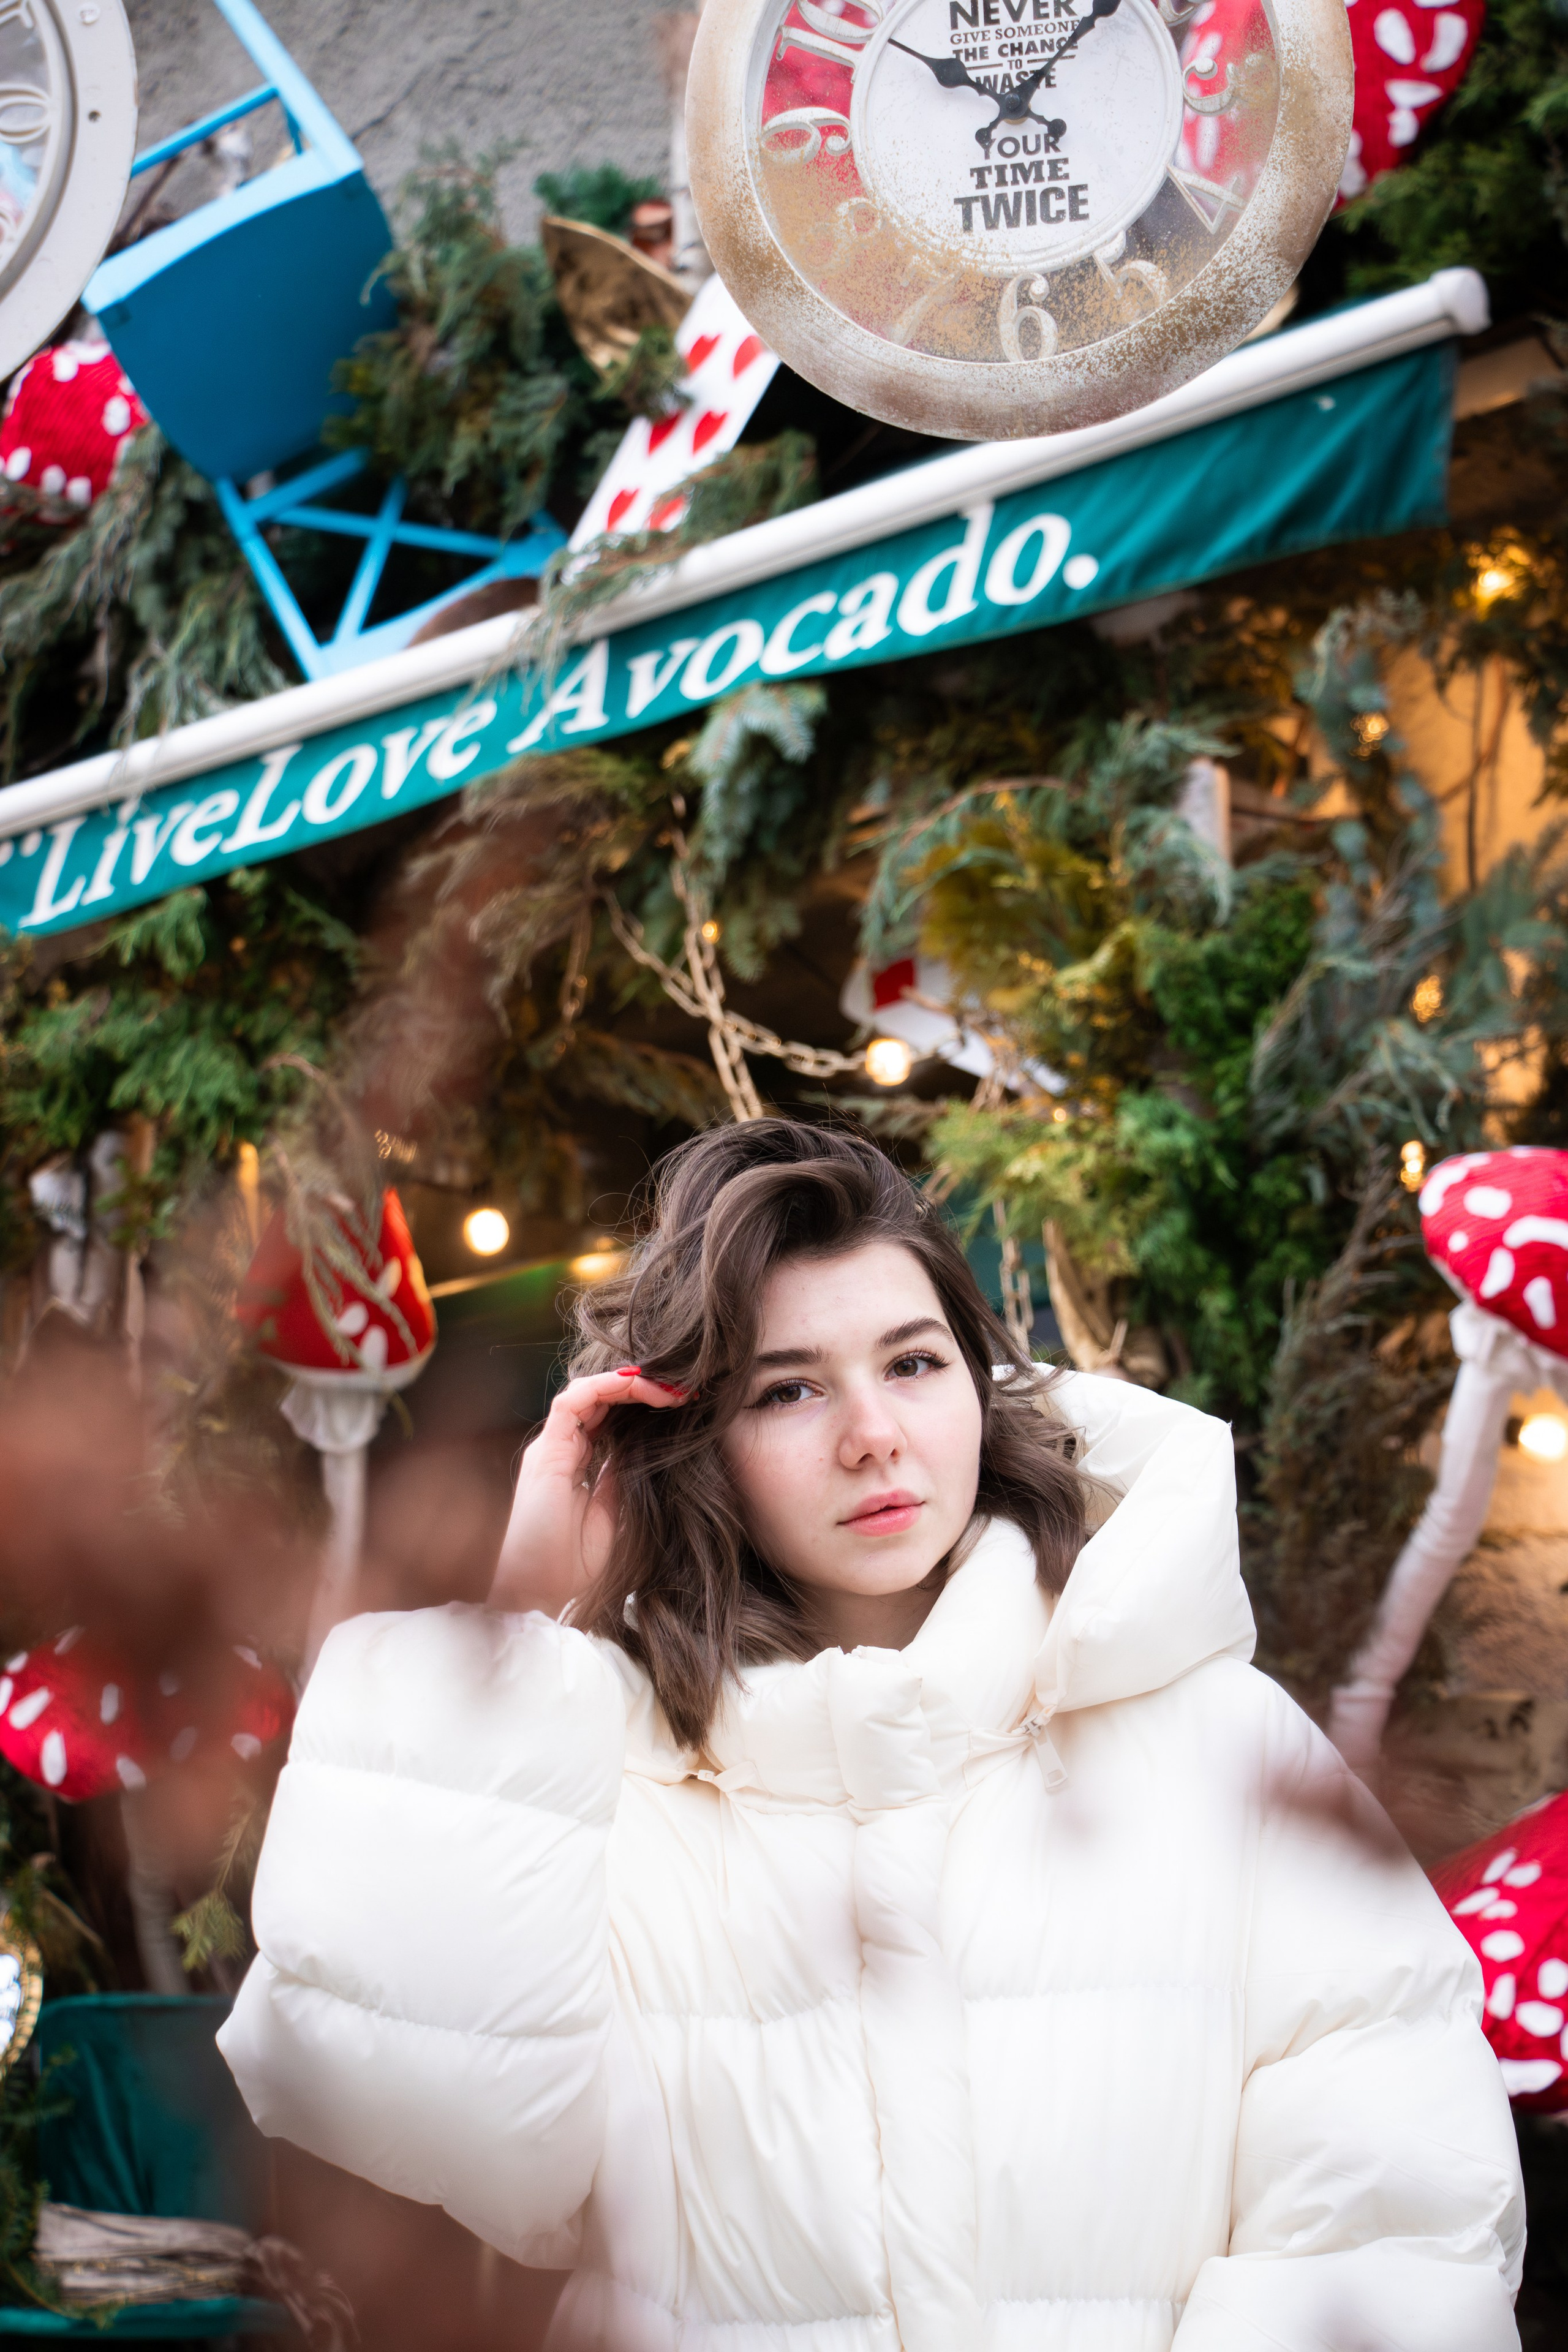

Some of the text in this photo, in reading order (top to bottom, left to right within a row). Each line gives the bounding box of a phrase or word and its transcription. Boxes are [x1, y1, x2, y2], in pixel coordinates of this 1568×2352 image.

[950, 19, 1080, 46] GIVE SOMEONE
[952, 43, 990, 62] THE
[1008, 59, 1023, 71] TO
[975, 67, 1058, 96] WASE
[970, 157, 1070, 190] TIME
[953, 184, 1090, 233] TWICE
